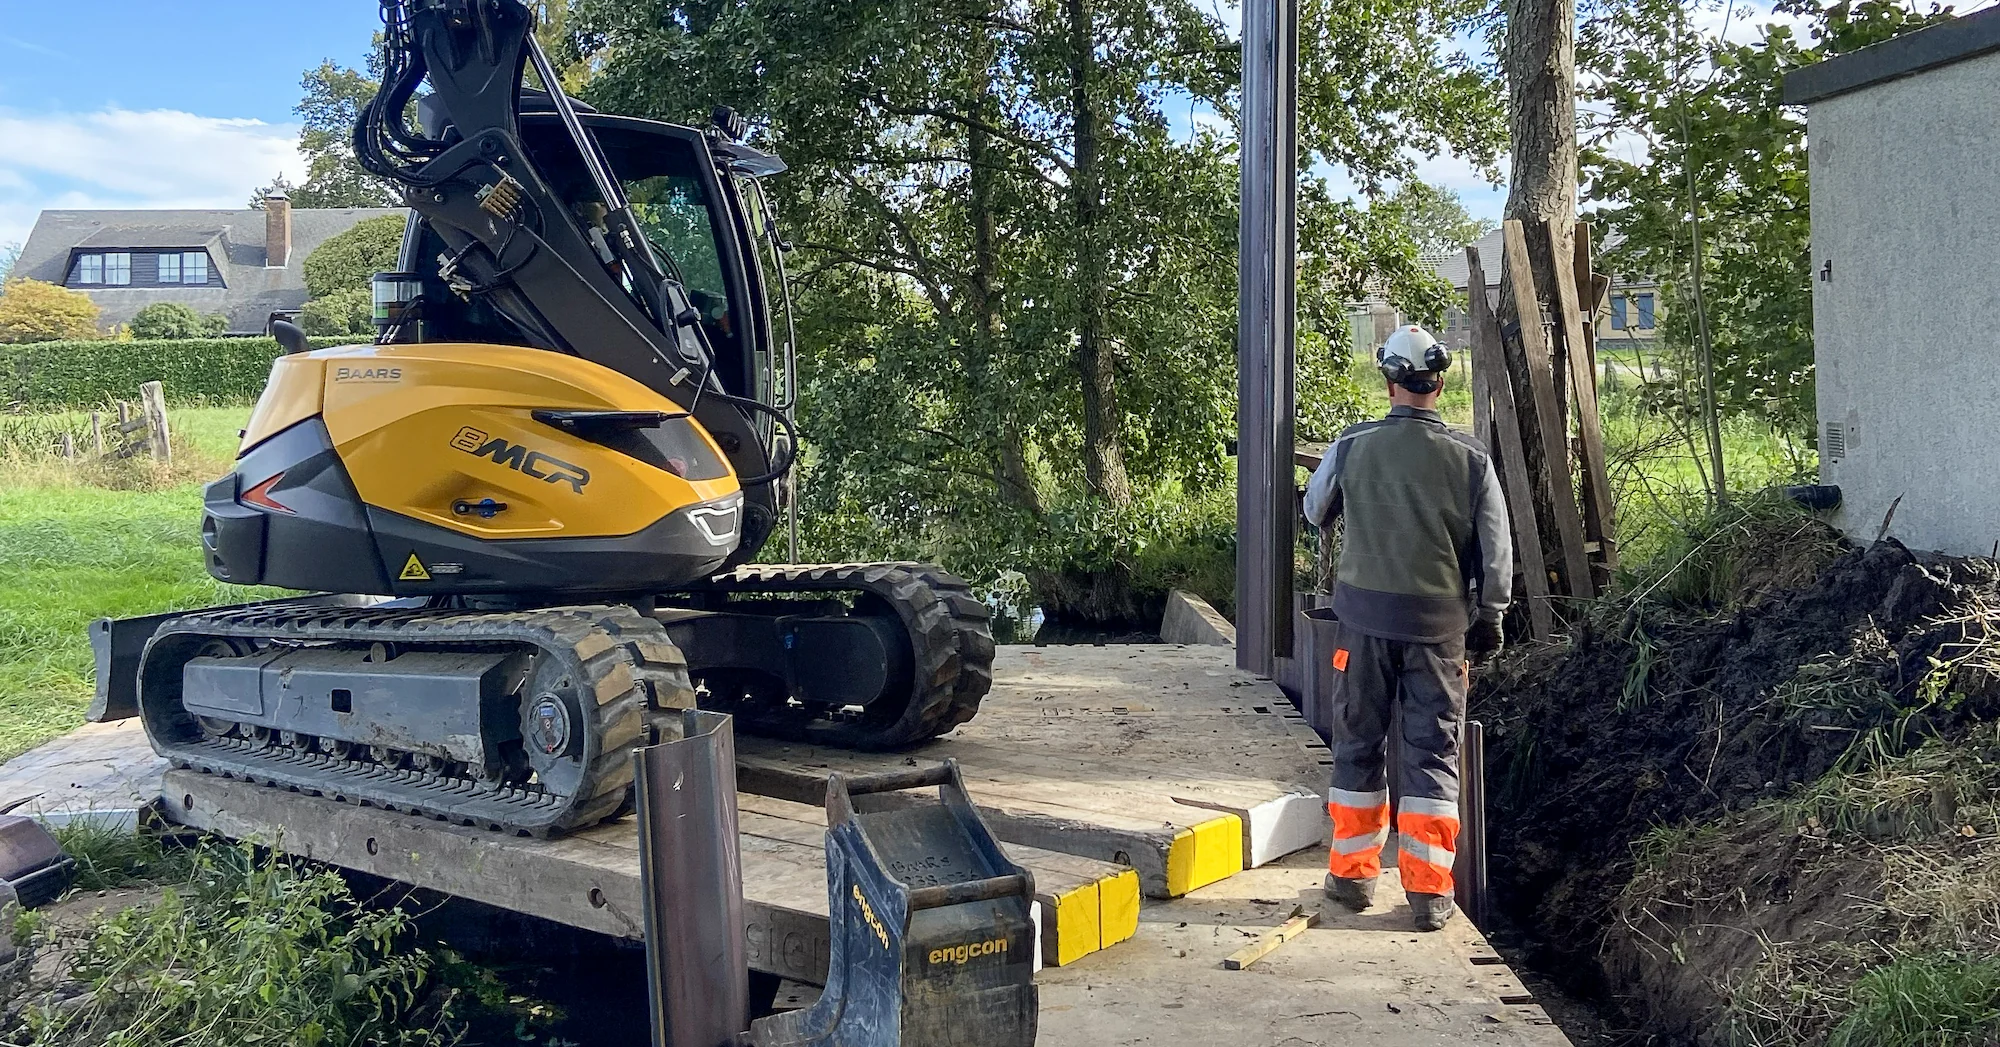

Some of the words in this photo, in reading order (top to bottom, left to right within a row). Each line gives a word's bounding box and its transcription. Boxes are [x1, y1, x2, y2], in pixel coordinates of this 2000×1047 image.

[335, 367, 403, 381] BAARS
[449, 425, 591, 495] 8MCR
[853, 884, 890, 950] engcon
[928, 937, 1008, 965] engcon
